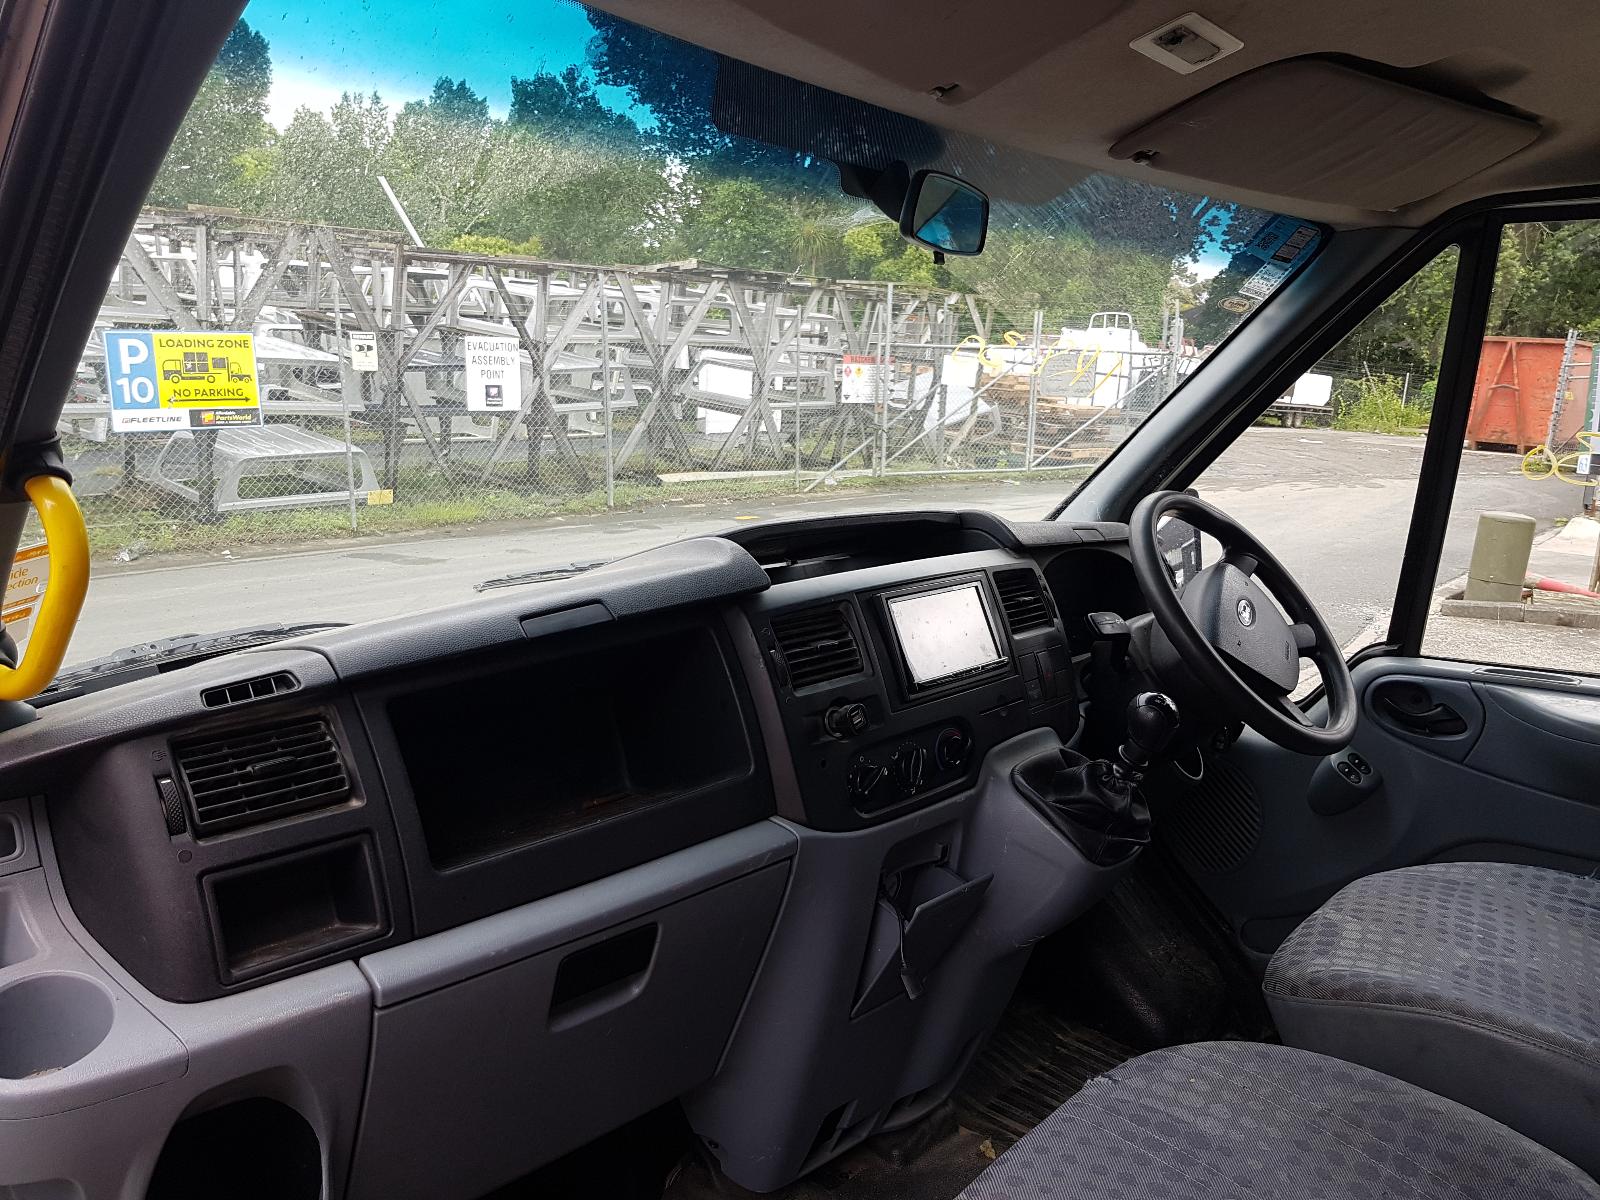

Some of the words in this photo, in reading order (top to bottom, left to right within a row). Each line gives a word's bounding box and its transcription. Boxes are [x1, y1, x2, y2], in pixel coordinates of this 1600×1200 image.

[159, 338, 214, 348] LOADING
[217, 339, 250, 348] ZONE
[467, 341, 519, 352] EVACUATION
[119, 338, 149, 375] P
[471, 355, 516, 366] ASSEMBLY
[480, 369, 505, 380] POINT
[116, 376, 154, 404] 10
[173, 388, 192, 398] NO
[194, 387, 244, 397] PARKING
[130, 415, 182, 424] FLEETLINE
